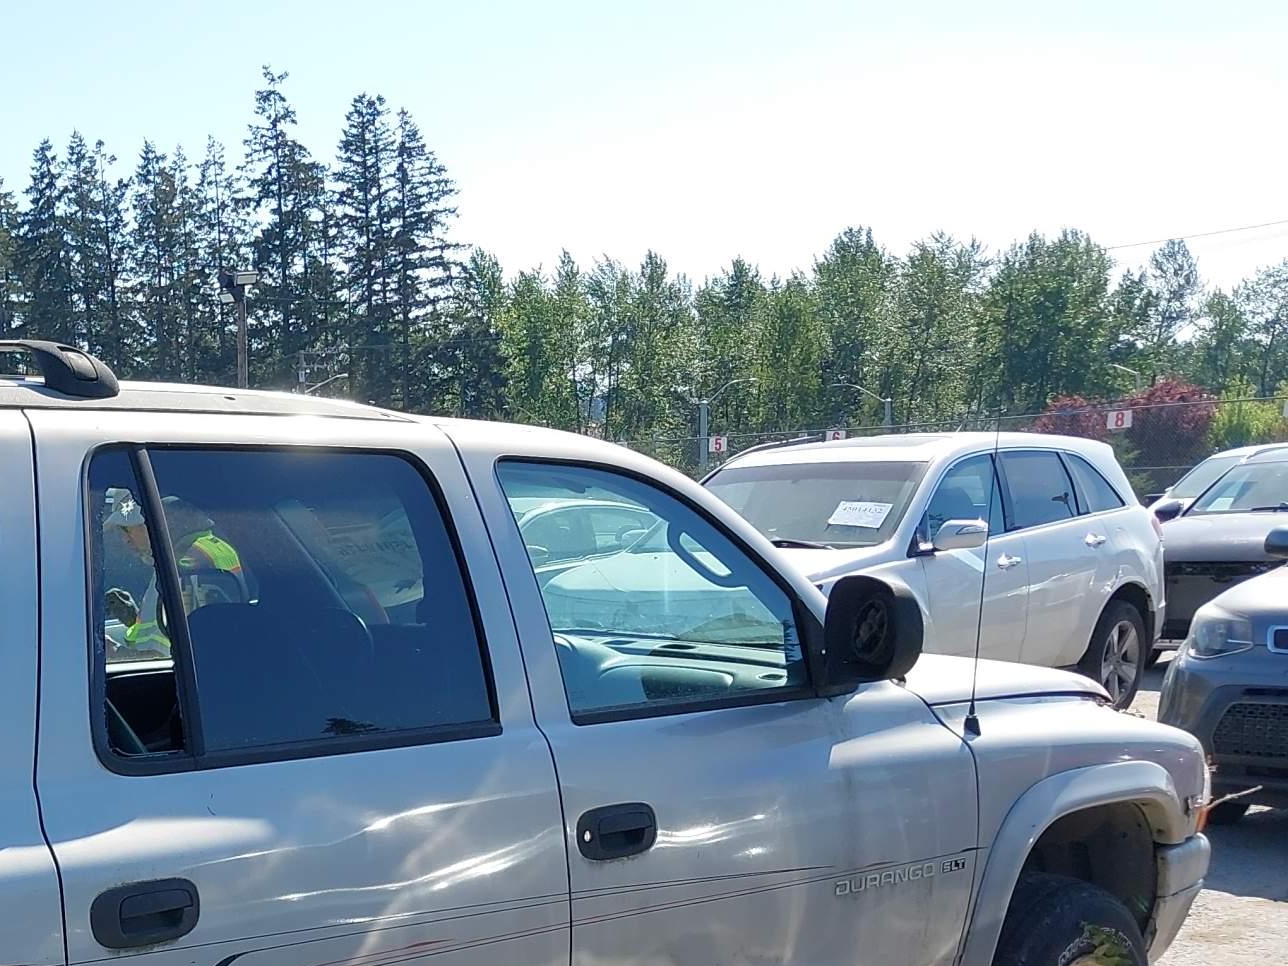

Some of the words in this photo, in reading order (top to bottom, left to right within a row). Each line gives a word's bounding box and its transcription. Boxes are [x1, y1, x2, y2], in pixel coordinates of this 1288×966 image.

[1114, 411, 1125, 427] 8
[831, 431, 841, 441] 6
[714, 437, 722, 451] 5
[834, 862, 936, 896] DURANGO
[940, 857, 967, 873] SLT
